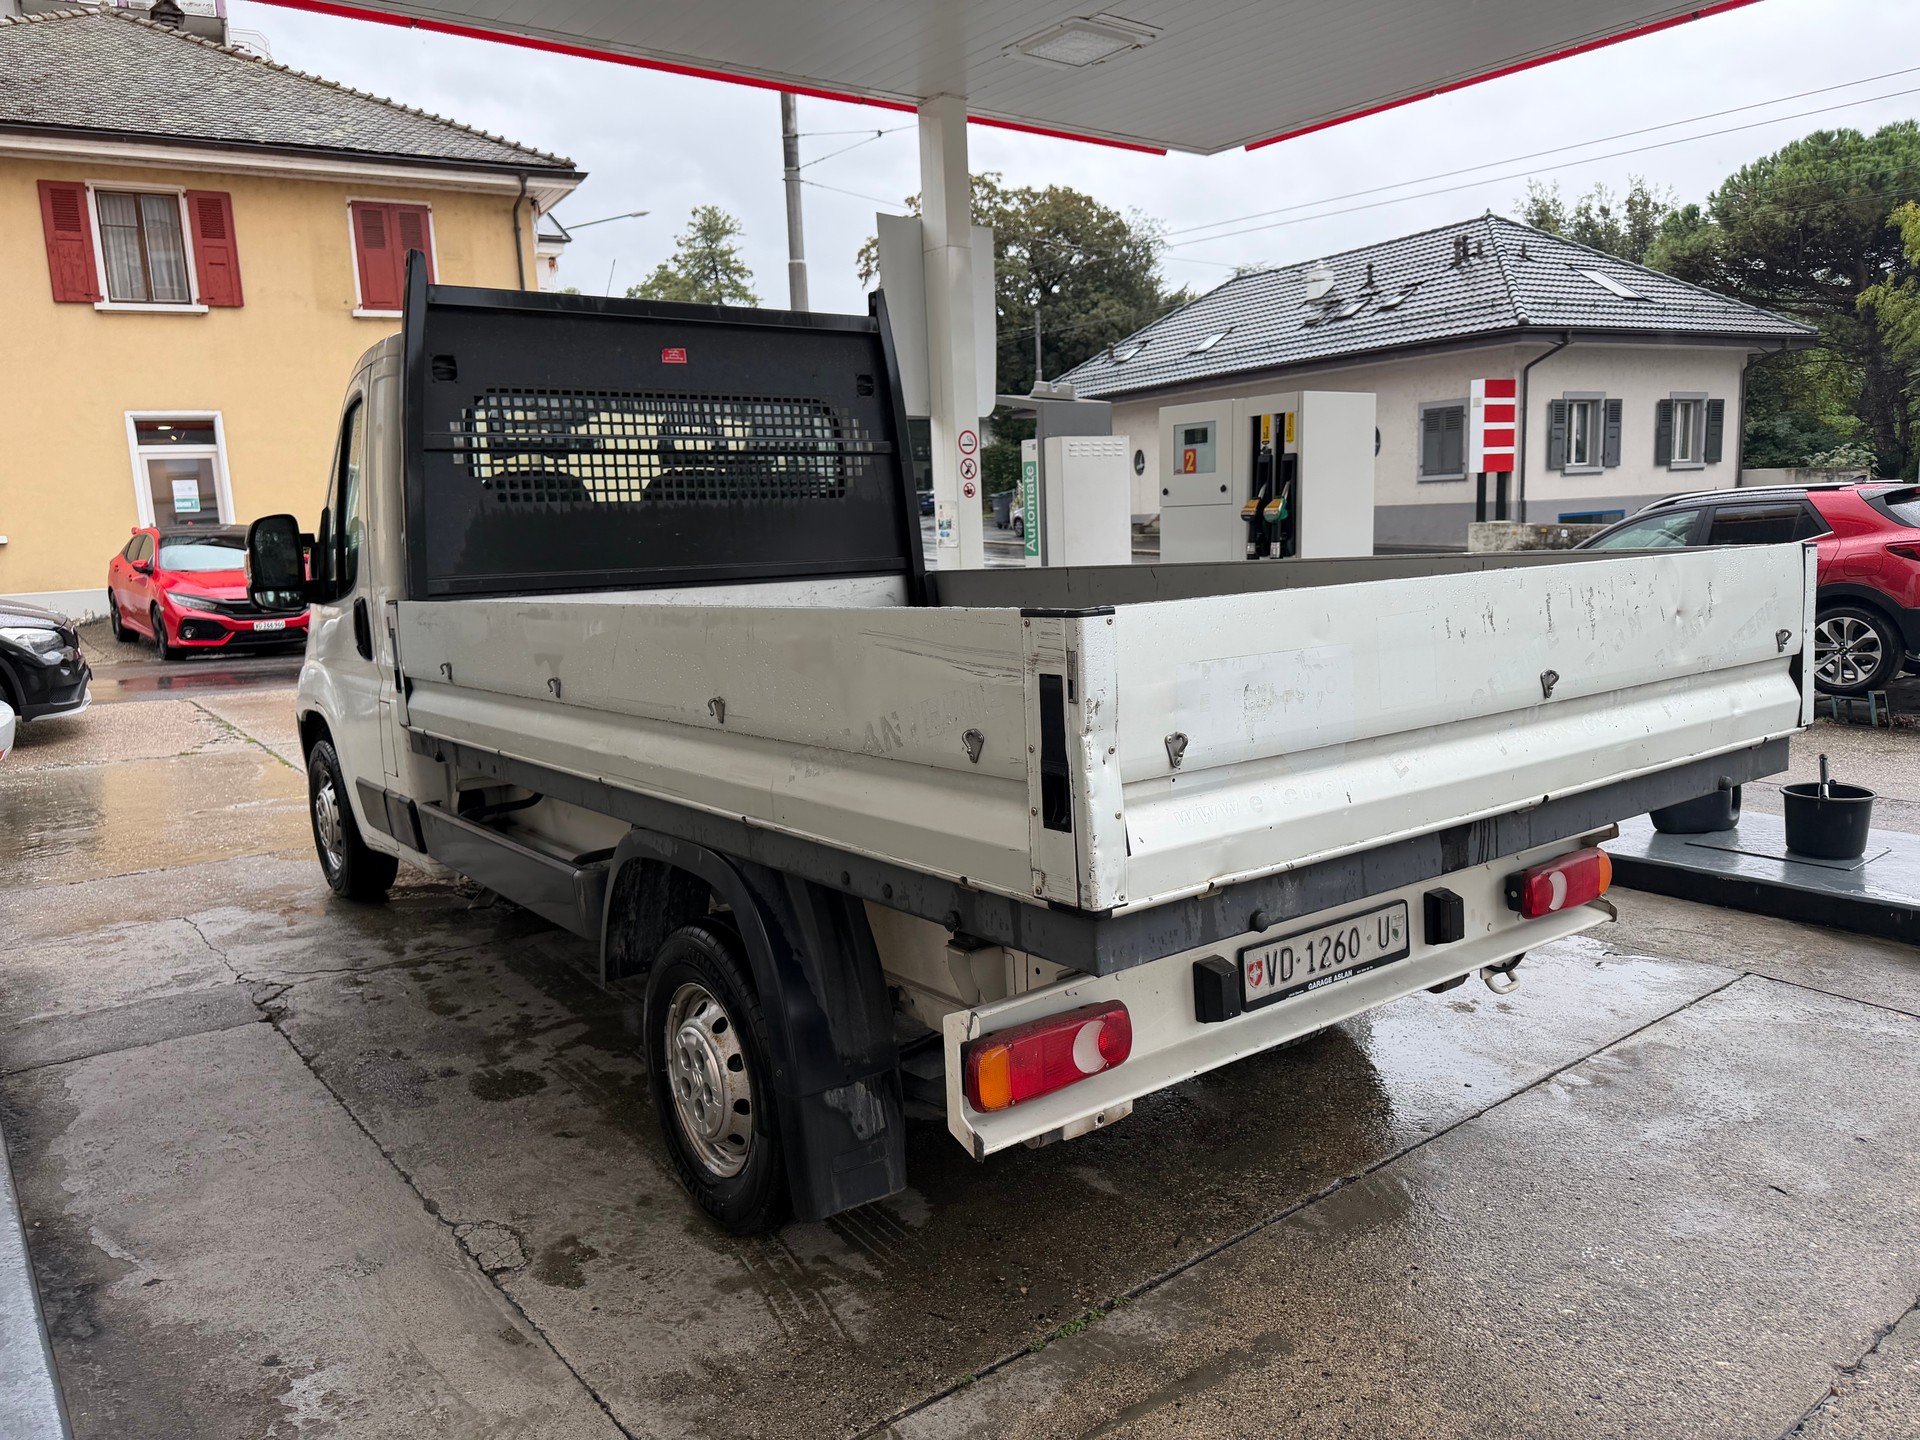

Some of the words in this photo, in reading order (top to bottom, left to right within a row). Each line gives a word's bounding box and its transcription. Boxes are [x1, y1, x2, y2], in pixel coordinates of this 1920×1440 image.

[1185, 451, 1195, 472] 2
[1025, 465, 1037, 552] Automate
[1264, 946, 1294, 987] VD
[1304, 927, 1361, 975] 1260
[1377, 914, 1391, 950] U
[1307, 976, 1333, 990] GARAGE
[1333, 969, 1353, 983] ASLAN
